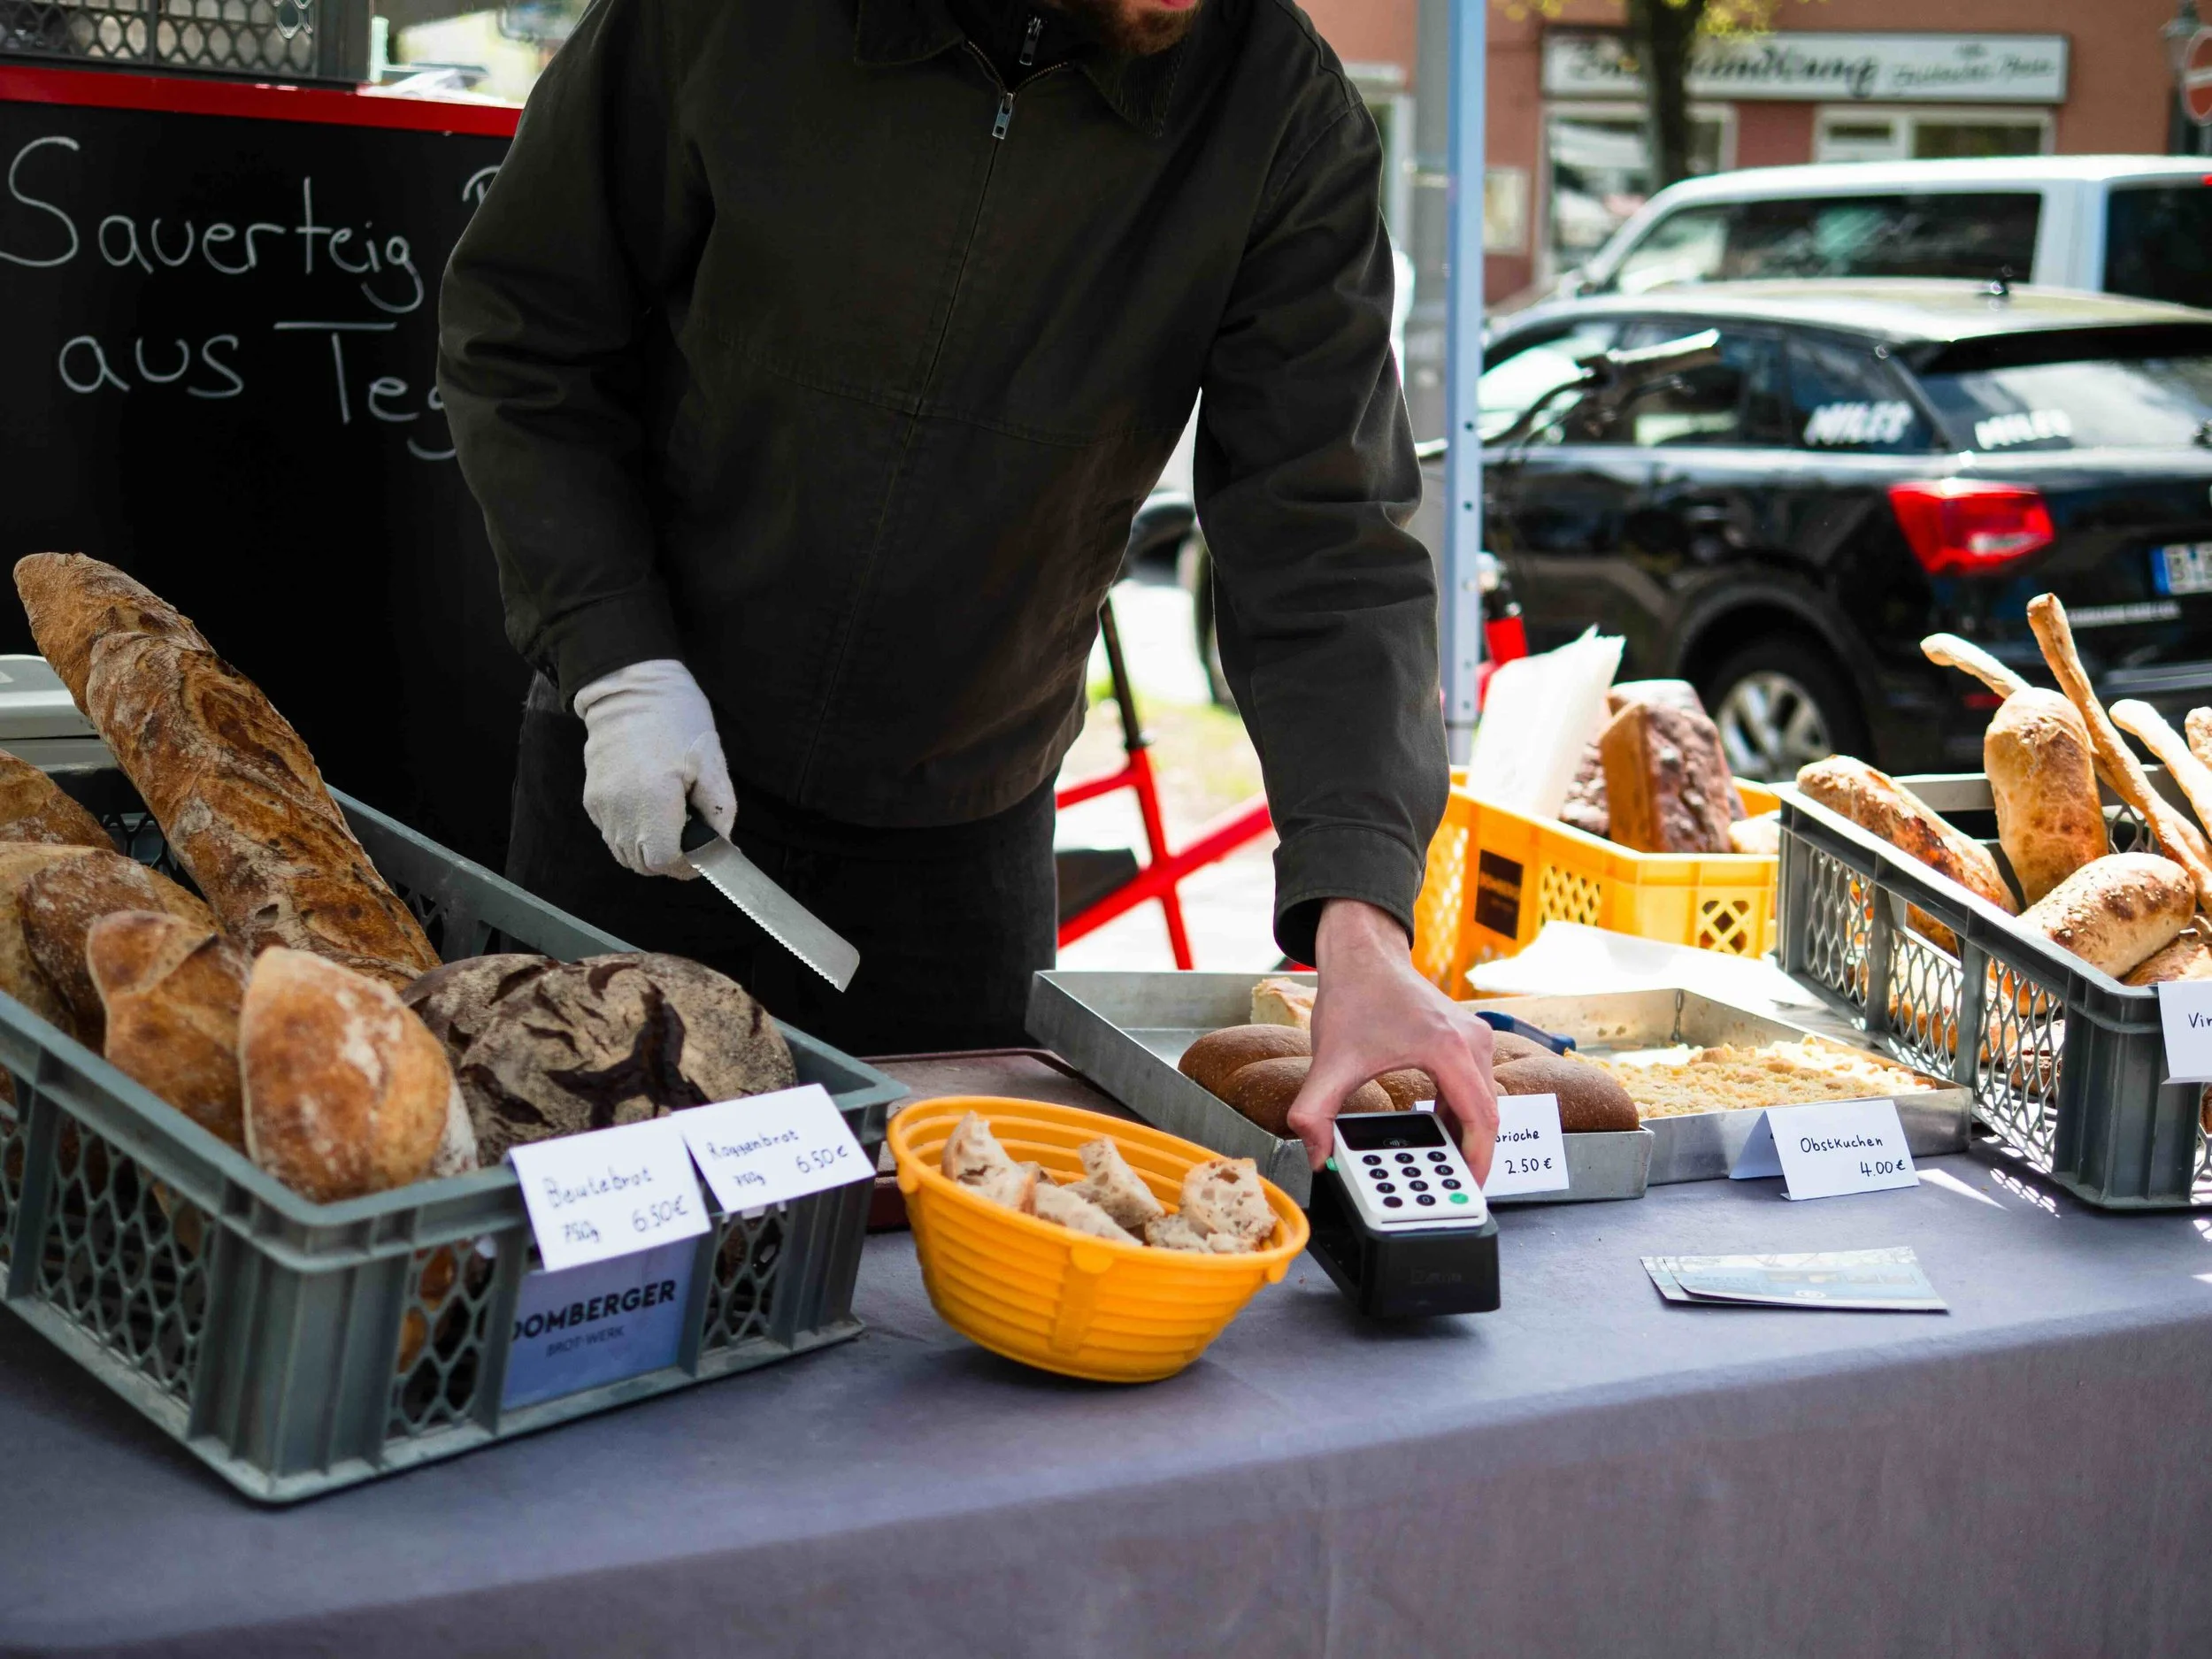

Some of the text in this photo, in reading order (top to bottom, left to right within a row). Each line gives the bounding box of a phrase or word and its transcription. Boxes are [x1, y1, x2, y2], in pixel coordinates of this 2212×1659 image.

[0, 135, 424, 313] Sauerteig
[58, 334, 244, 398] aus
[706, 1130, 800, 1160] Roggenbrot
[541, 1164, 654, 1209] Beutebrot
[733, 1171, 767, 1187] 750g
[562, 1219, 601, 1243] 750g
